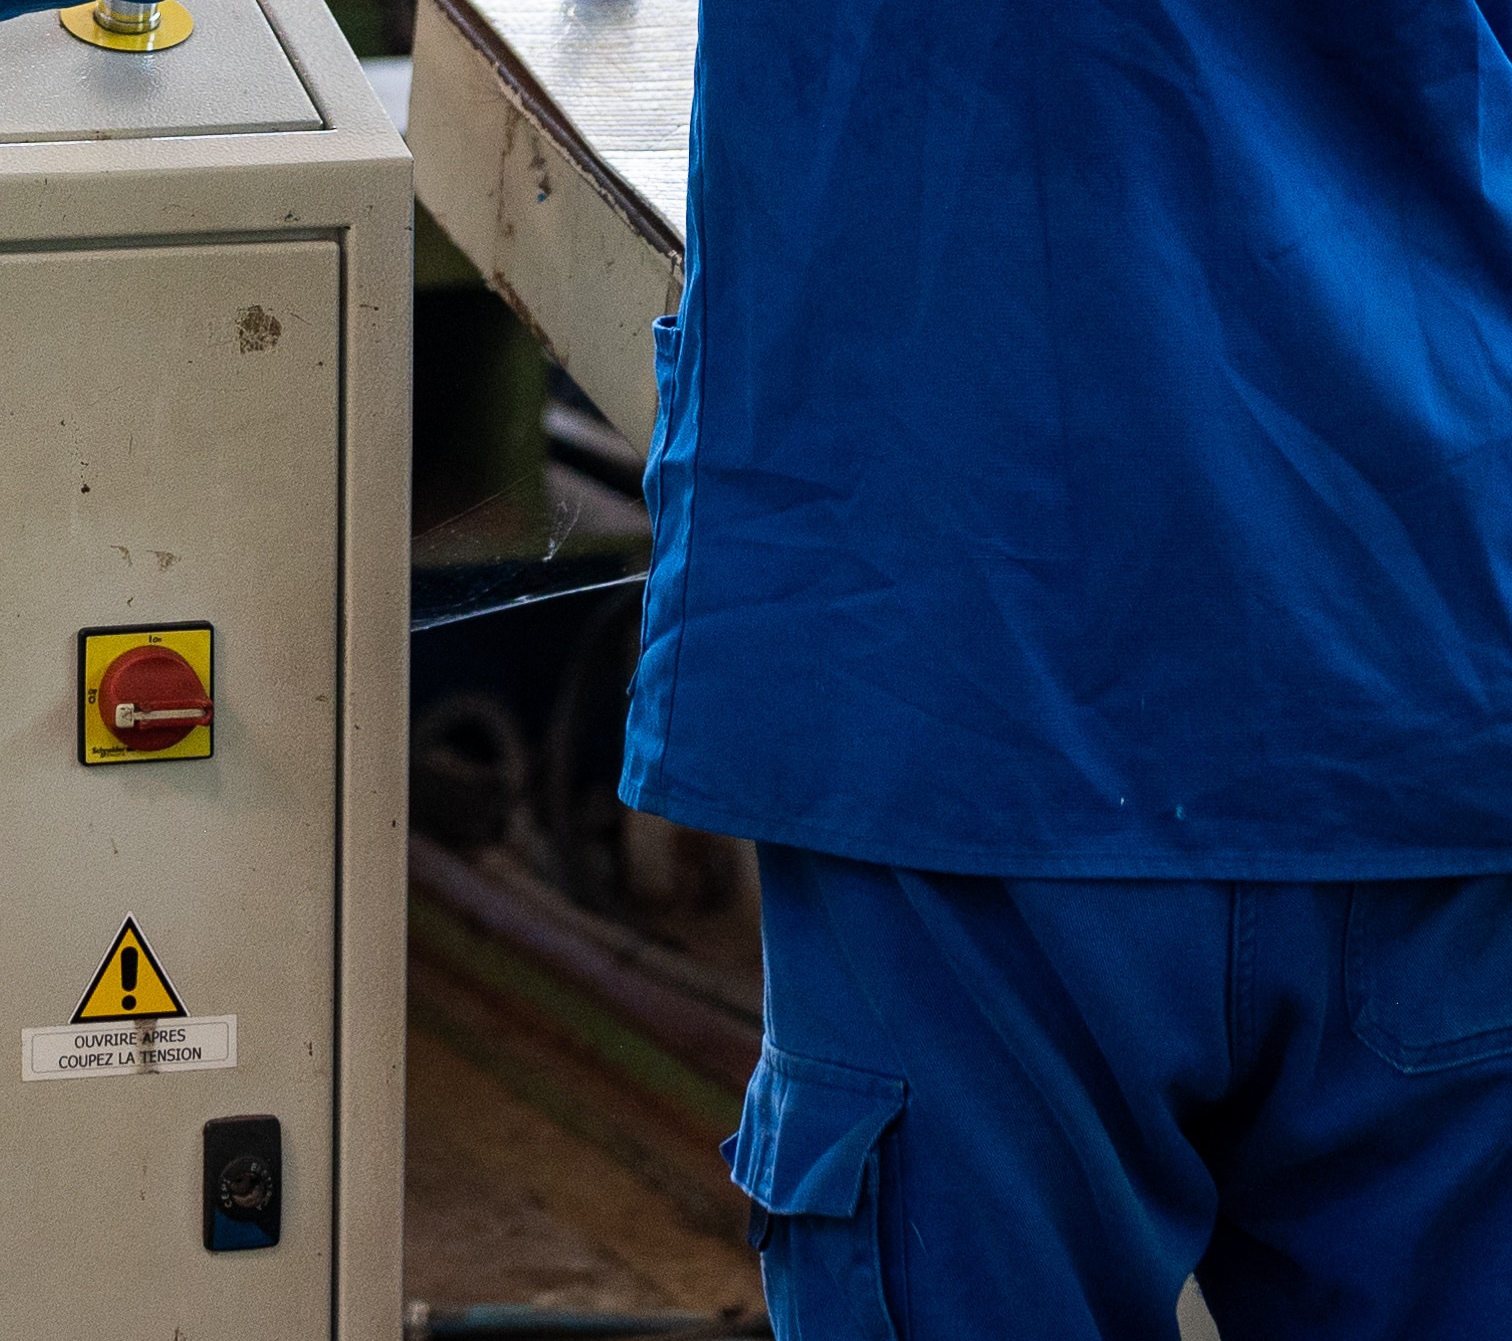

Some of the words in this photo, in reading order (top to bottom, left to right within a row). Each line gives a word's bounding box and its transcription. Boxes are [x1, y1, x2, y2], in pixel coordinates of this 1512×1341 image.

[74, 1032, 137, 1049] OUVRIRE
[142, 1028, 186, 1044] APRES
[58, 1053, 113, 1069] COUPEZ
[118, 1051, 135, 1065] LA
[141, 1047, 202, 1064] TENSION
